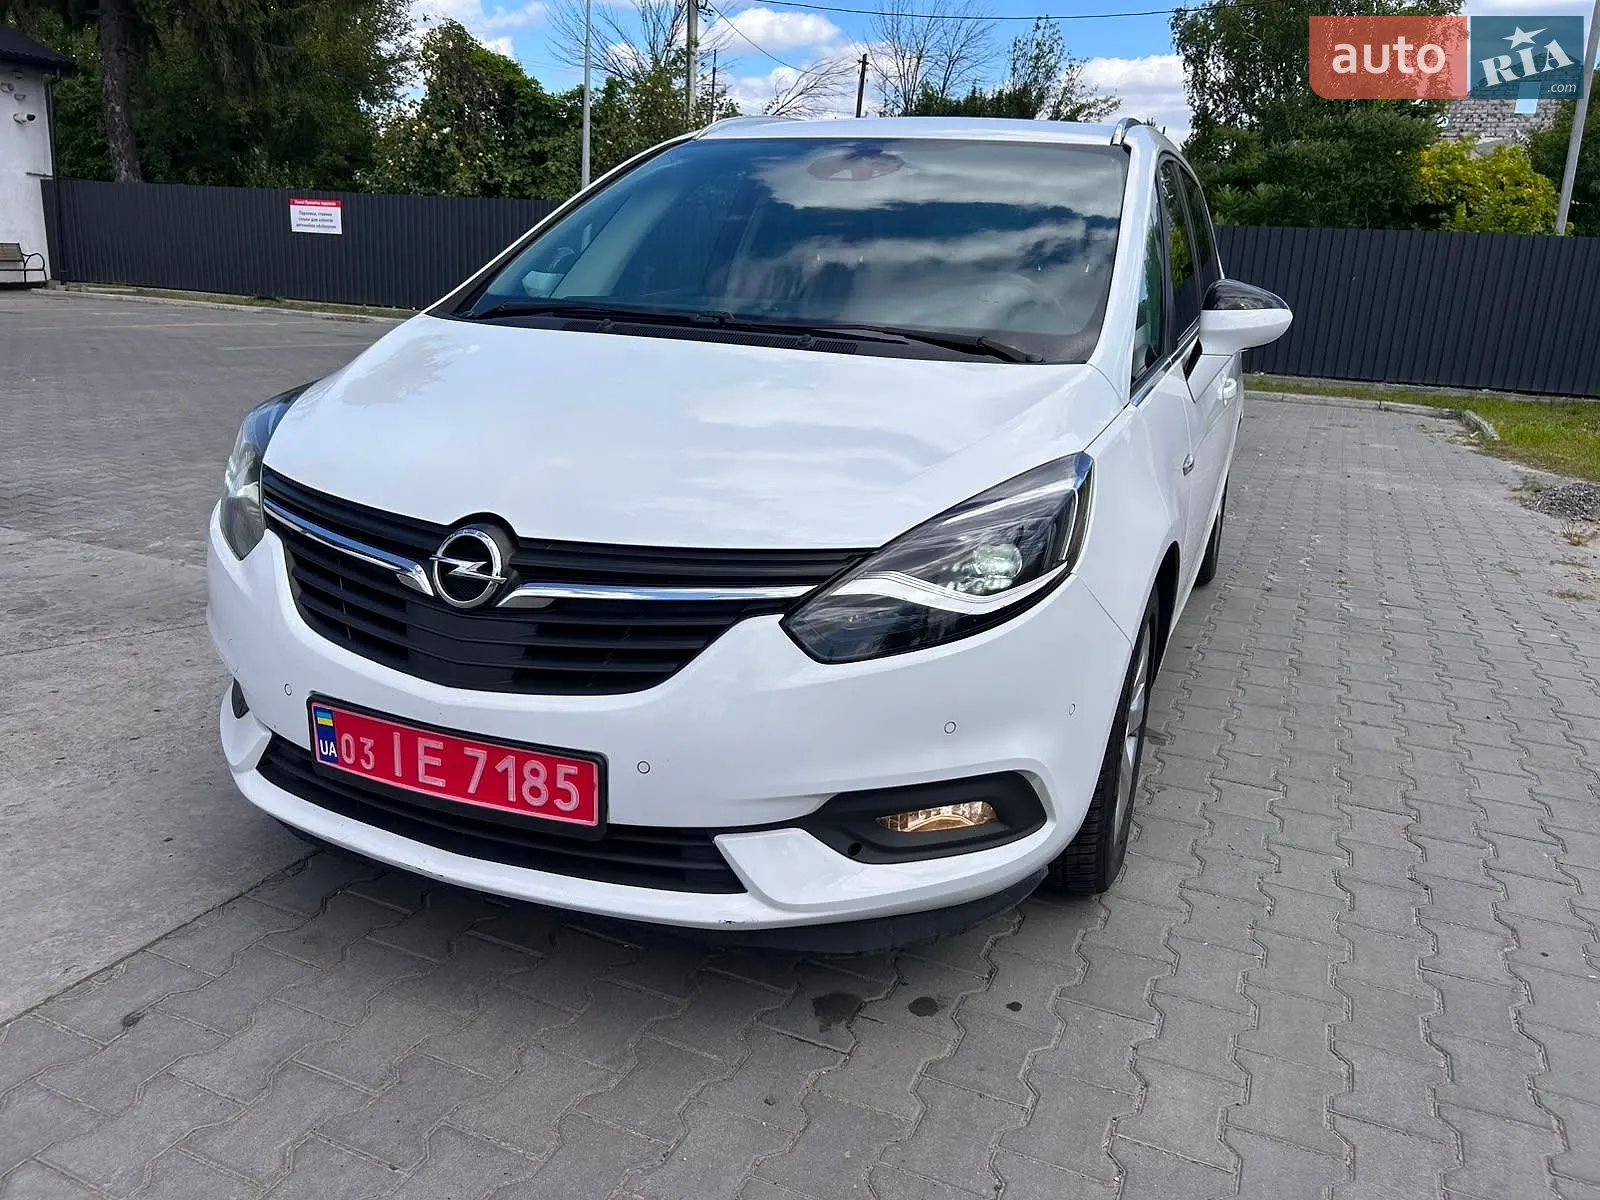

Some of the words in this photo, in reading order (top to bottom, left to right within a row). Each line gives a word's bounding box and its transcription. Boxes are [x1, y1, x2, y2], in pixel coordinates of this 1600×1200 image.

[319, 739, 337, 758] UA
[341, 732, 375, 770] 03
[463, 747, 580, 812] 7185
